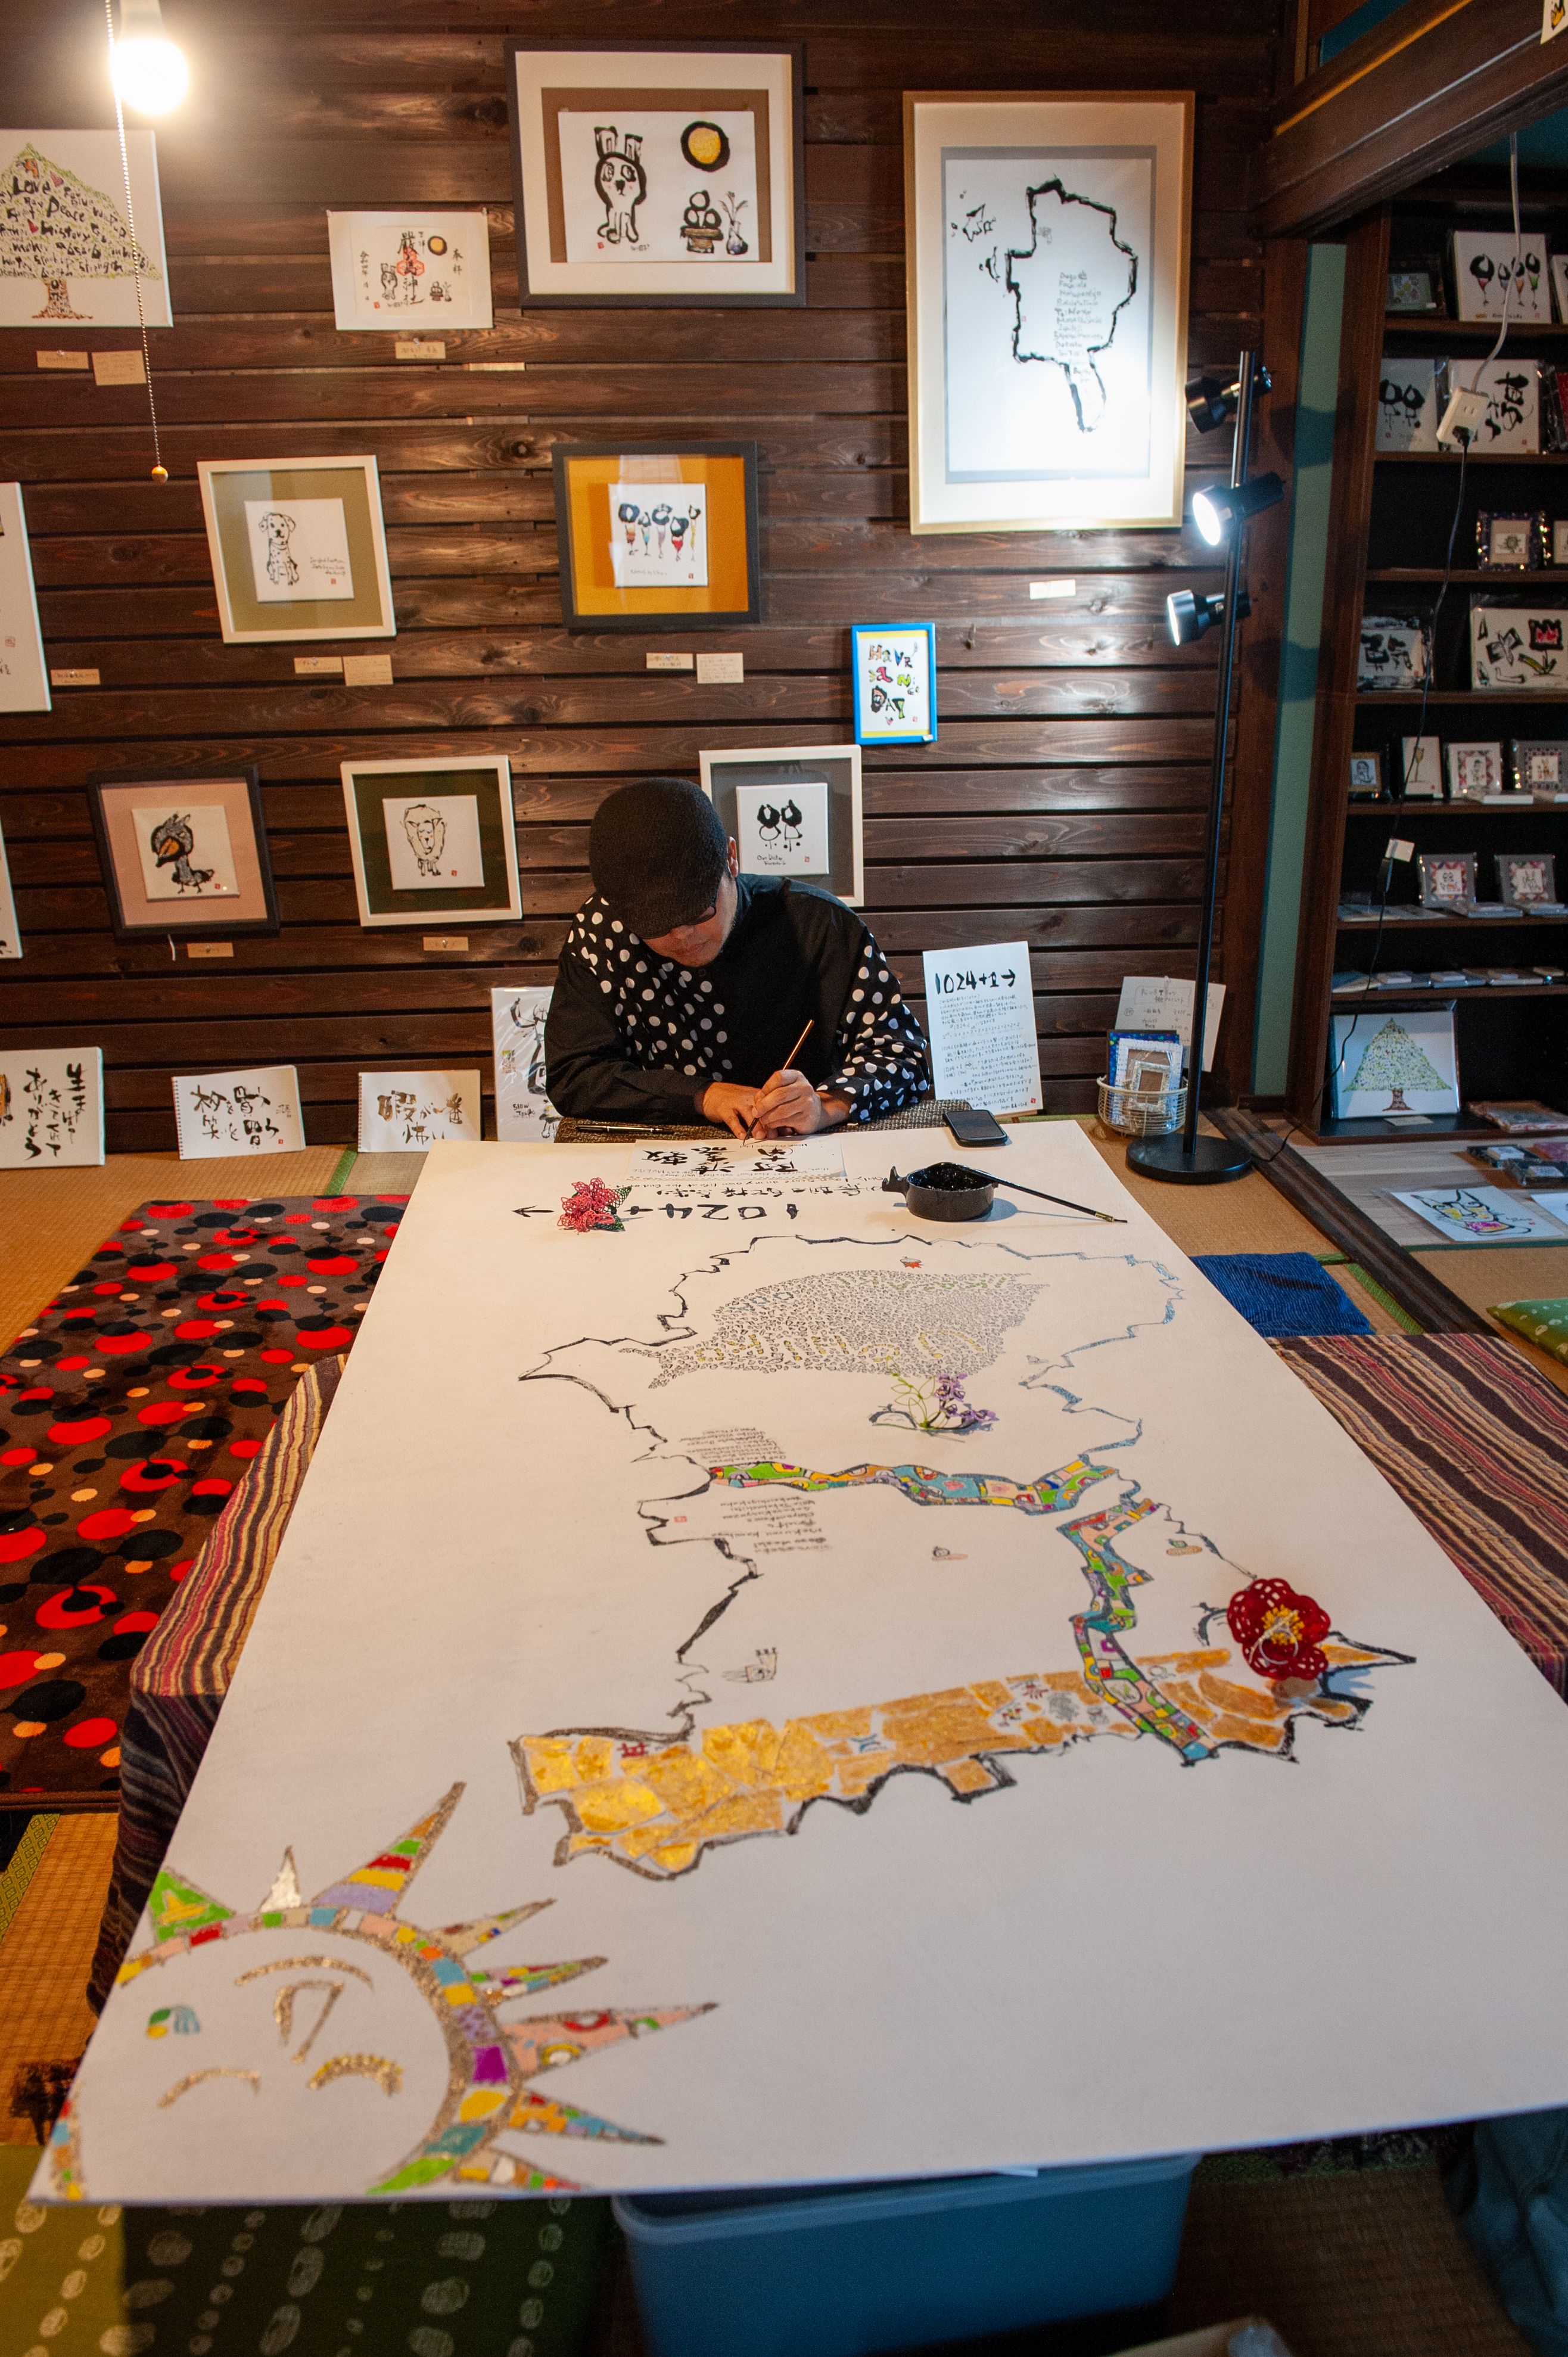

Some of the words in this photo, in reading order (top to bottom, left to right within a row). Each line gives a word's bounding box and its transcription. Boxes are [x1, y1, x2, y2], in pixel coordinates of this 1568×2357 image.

[13, 176, 51, 195] Love
[46, 195, 85, 222] Peace
[23, 1068, 48, 1160] ありがとう
